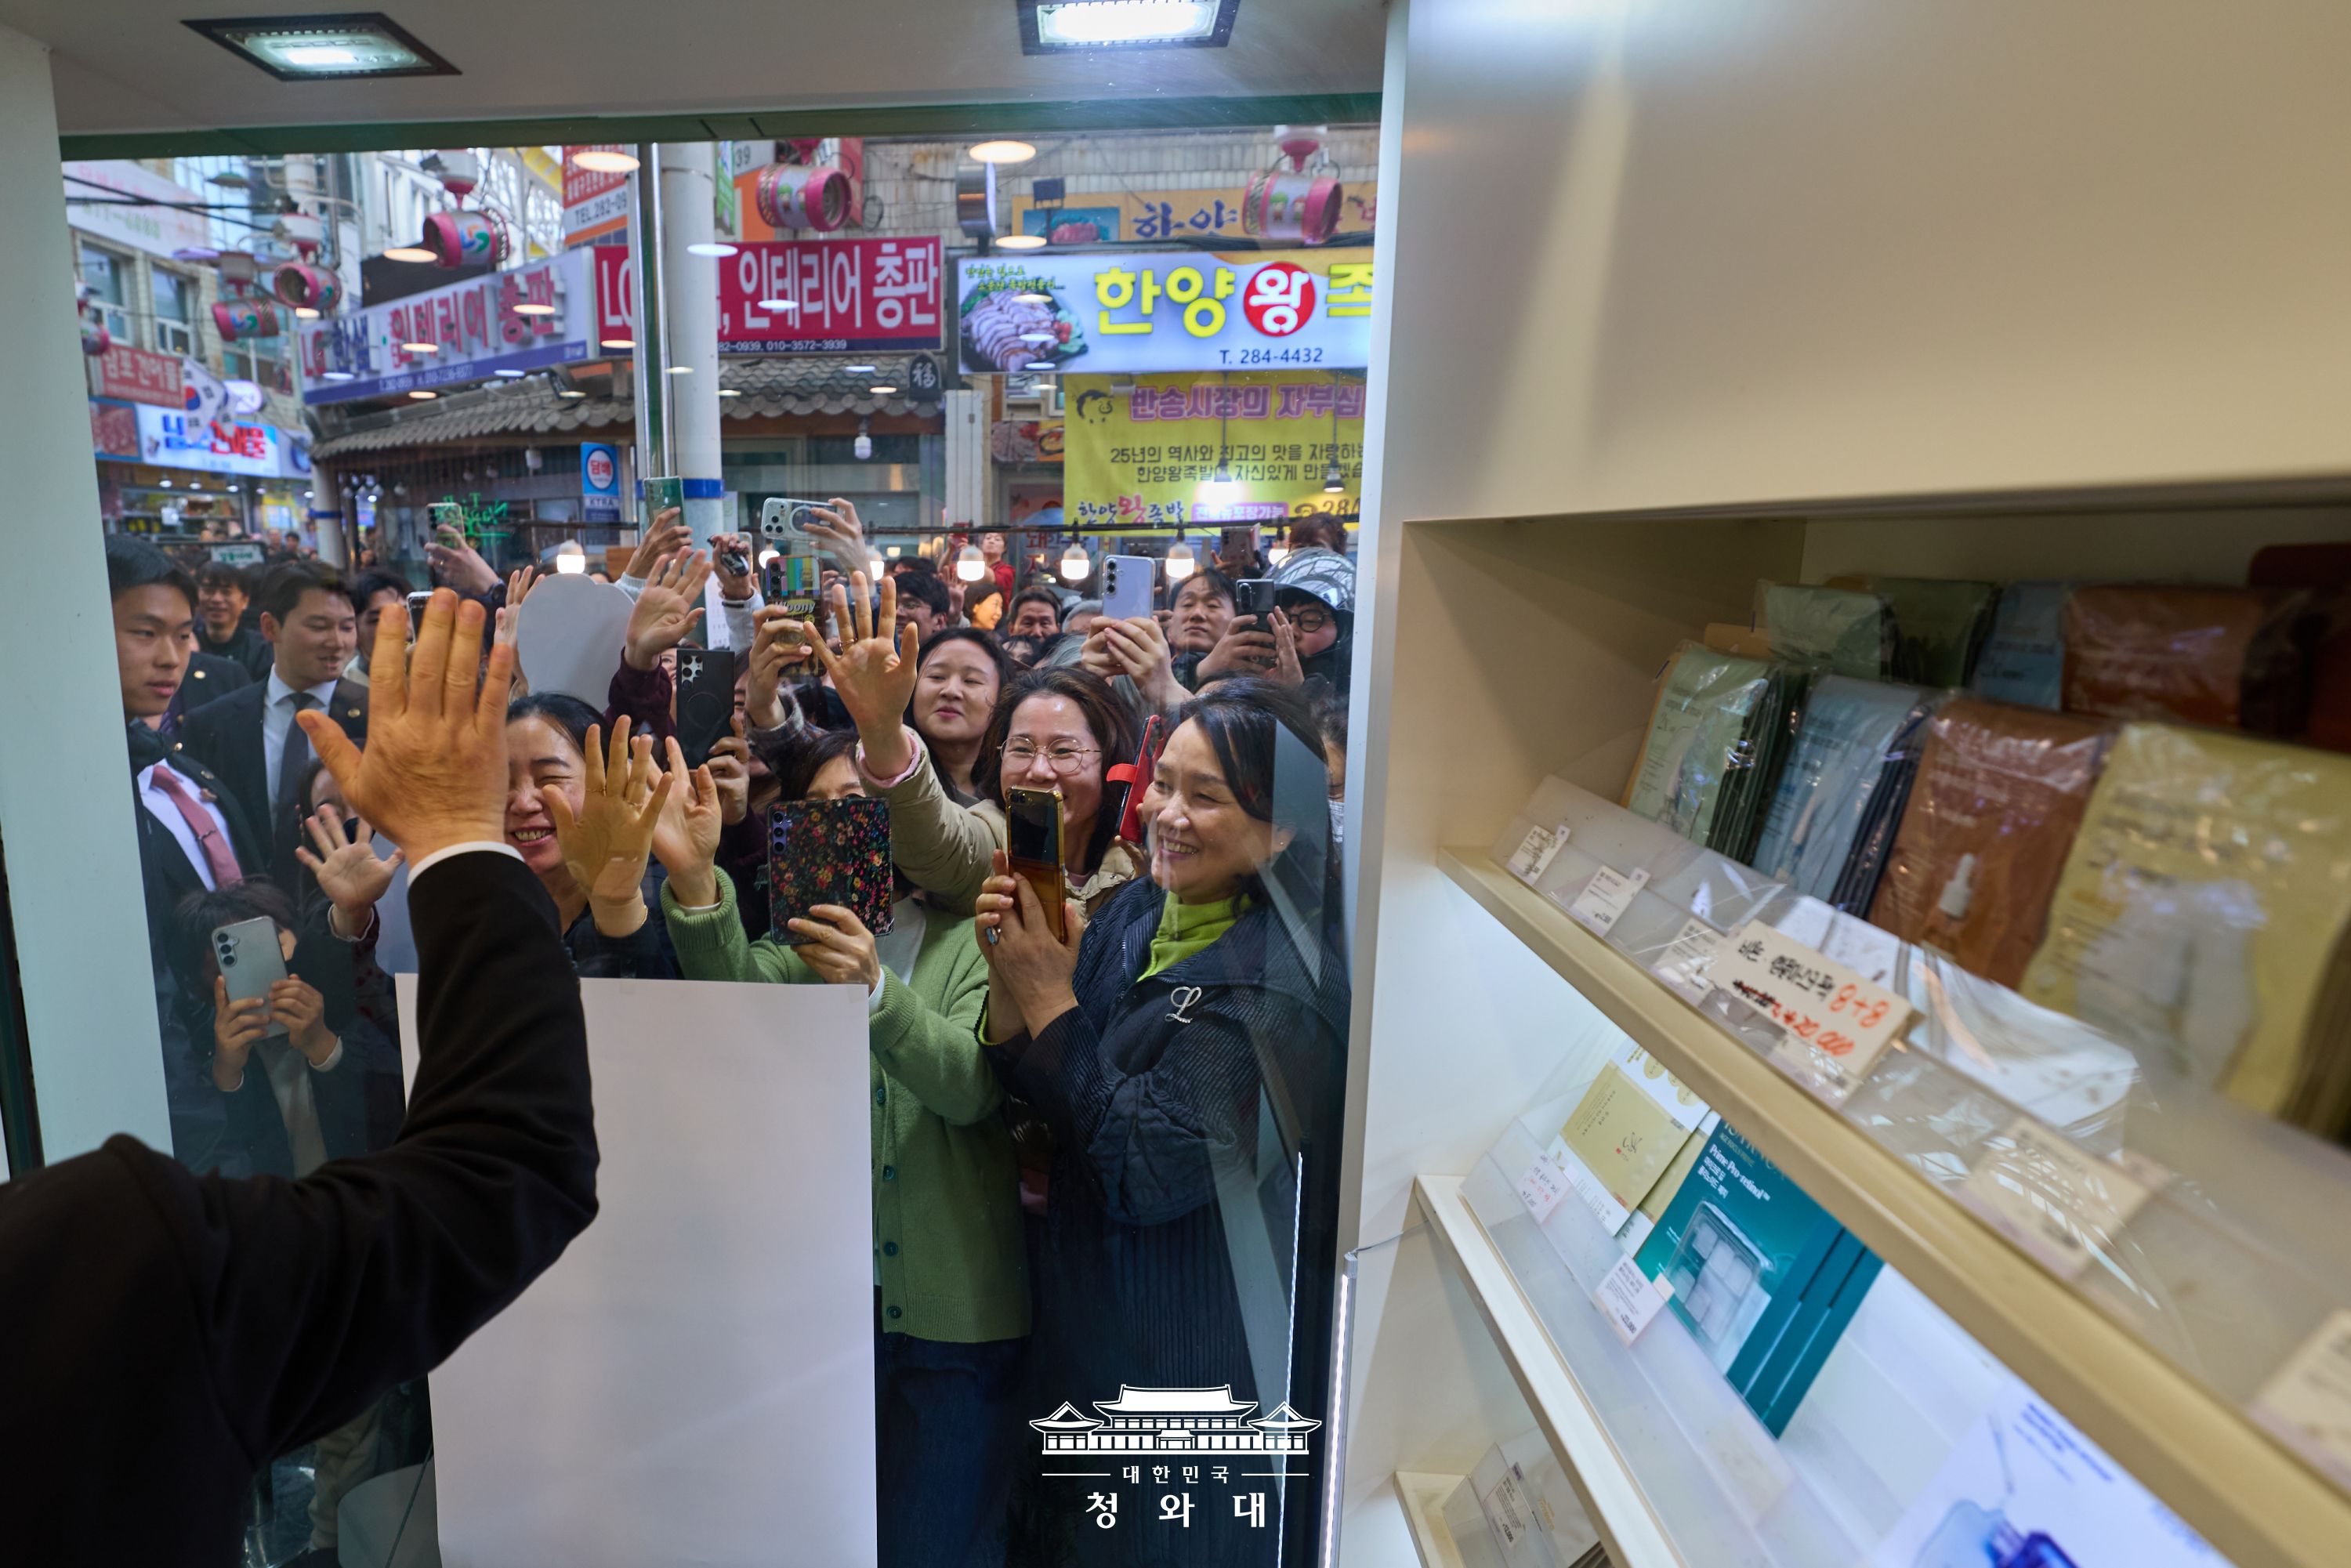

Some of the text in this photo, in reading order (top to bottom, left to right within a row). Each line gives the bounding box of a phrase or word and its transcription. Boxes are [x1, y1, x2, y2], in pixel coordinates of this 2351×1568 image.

[739, 247, 862, 330] 인테리어
[872, 241, 939, 329] 총판
[389, 282, 490, 369] 인테리어
[766, 339, 847, 351] 010-3572-3939
[1240, 347, 1324, 364] 284-4432
[1129, 382, 1363, 422] 반송시장의 자부심
[1110, 445, 1162, 464] 25년의
[1168, 444, 1214, 463] 역사와
[1272, 444, 1302, 462] 맛을
[1235, 464, 1297, 482] 자신있게
[1829, 983, 1891, 1029] 8+8
[1709, 1144, 1728, 1167] Prime
